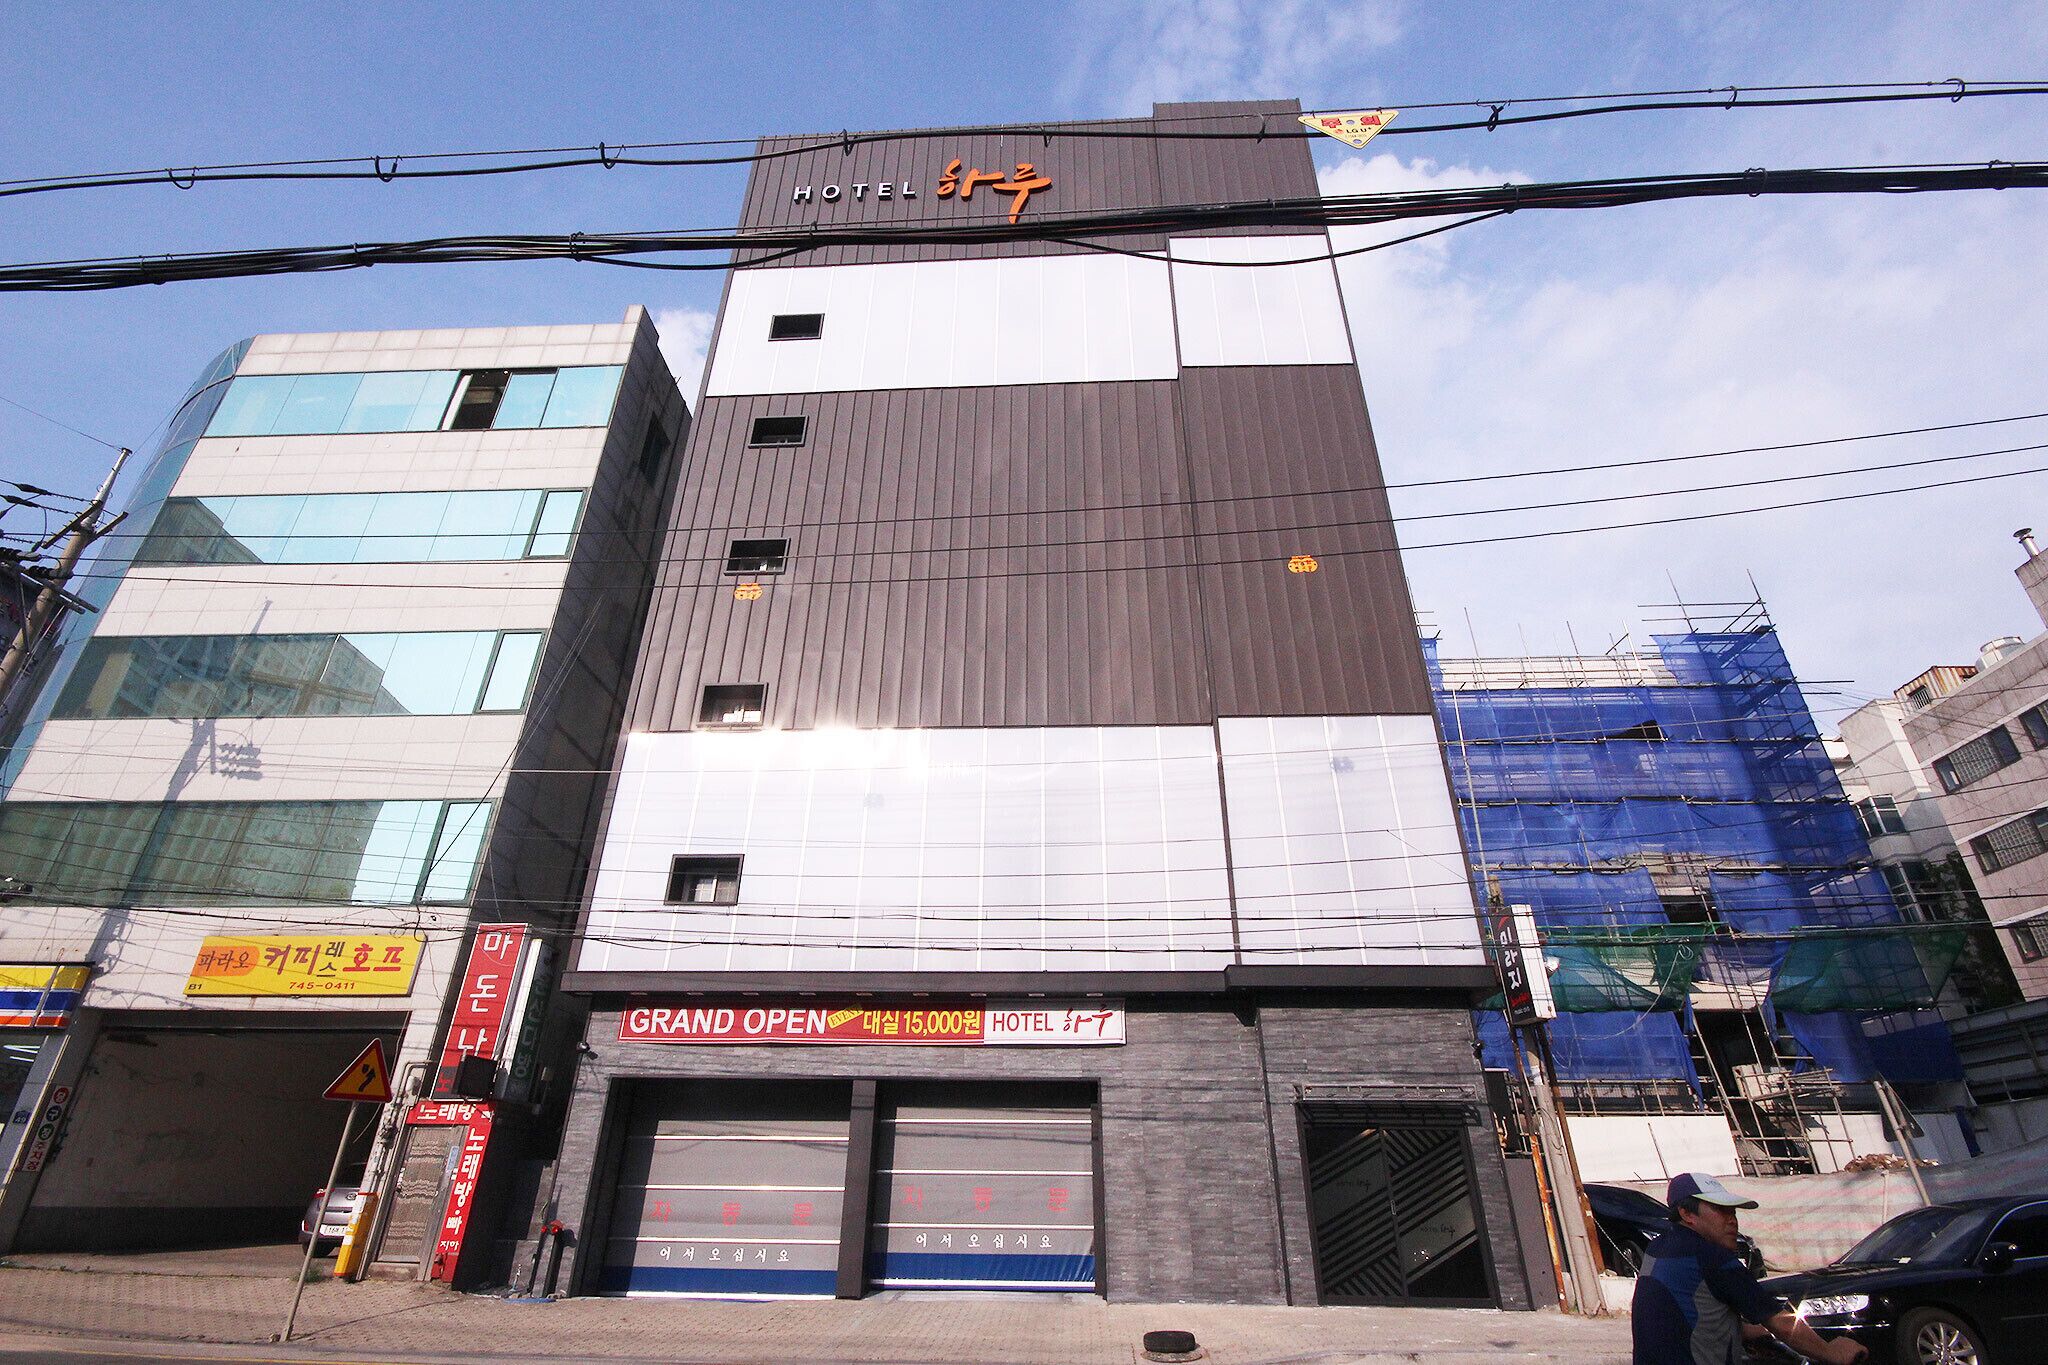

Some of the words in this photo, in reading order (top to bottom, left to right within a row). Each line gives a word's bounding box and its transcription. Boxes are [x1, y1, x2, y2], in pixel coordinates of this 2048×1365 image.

[793, 181, 917, 202] HOTEL
[936, 158, 1052, 225] 하루
[197, 951, 250, 972] 파라오
[263, 943, 322, 976] 커피
[342, 942, 404, 973] 호프
[1499, 926, 1522, 990] 미라지
[187, 983, 203, 991] B1
[288, 981, 356, 991] 745-0411
[457, 931, 514, 1058] 마돈나
[628, 1008, 735, 1035] GRAND
[742, 1008, 828, 1035] OPEN
[862, 1009, 900, 1035] 대실
[903, 1009, 981, 1037] 15,000원
[992, 1012, 1054, 1032] HOTEL
[416, 1103, 477, 1121] 노래방
